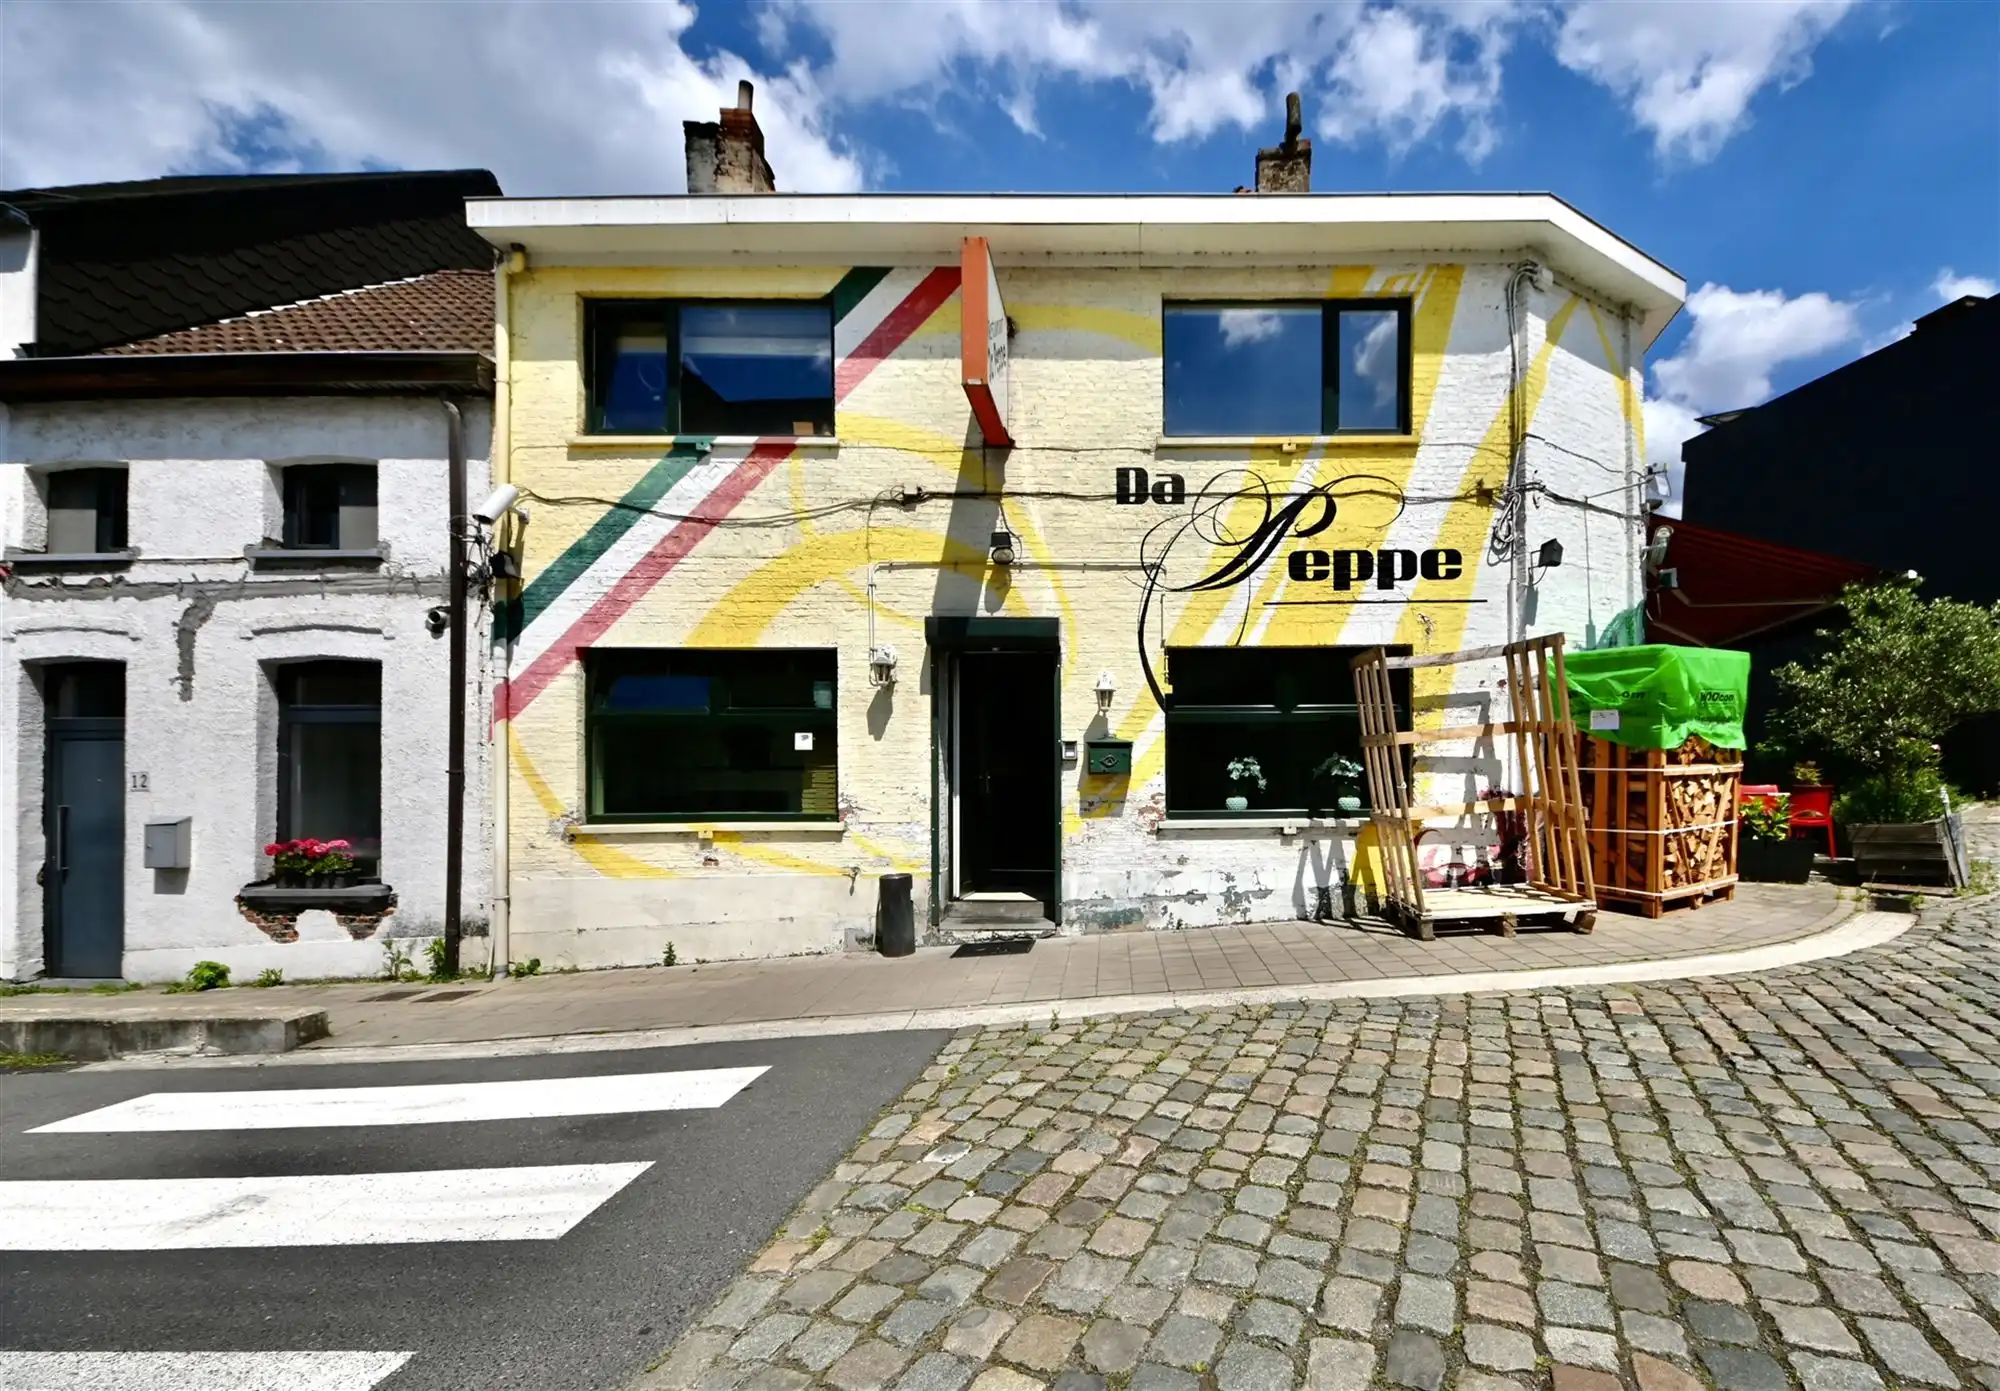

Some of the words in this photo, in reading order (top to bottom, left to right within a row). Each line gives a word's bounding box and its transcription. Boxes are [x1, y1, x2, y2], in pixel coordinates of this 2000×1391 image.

[1115, 466, 1186, 505] Da
[1126, 470, 1463, 714] Peppe
[132, 774, 148, 789] 12
